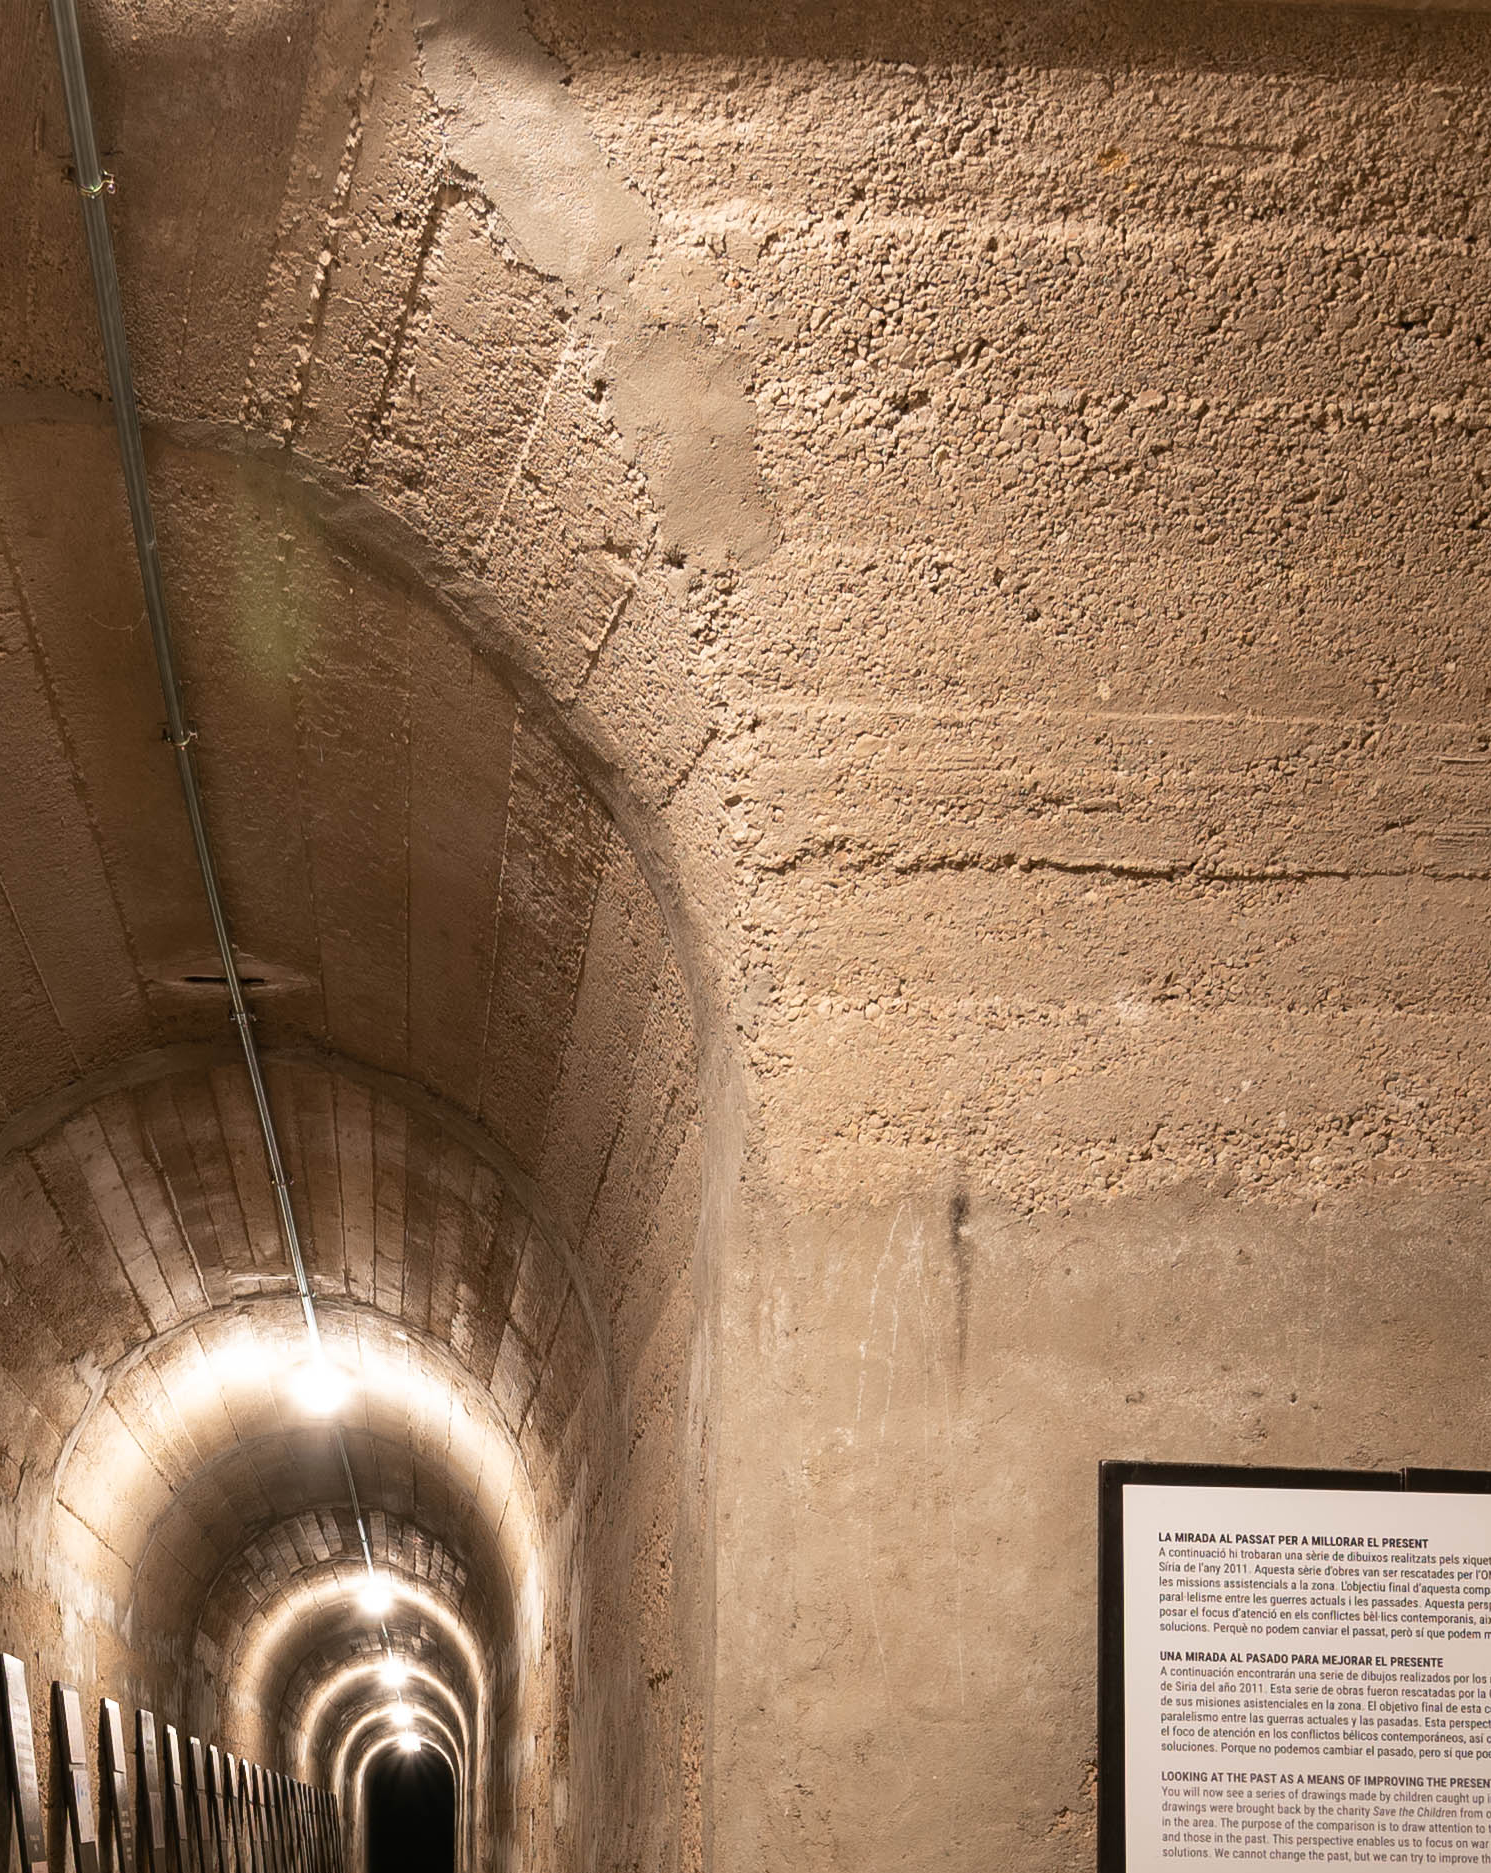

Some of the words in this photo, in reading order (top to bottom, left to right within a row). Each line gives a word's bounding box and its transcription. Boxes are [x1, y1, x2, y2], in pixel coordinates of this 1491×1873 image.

[1157, 1531, 1172, 1543] LA
[1174, 1531, 1217, 1544] MIRADA
[1218, 1532, 1233, 1544] AL
[1234, 1533, 1276, 1545] PASSAT
[1277, 1534, 1298, 1546] PER
[1300, 1534, 1309, 1546] A
[1310, 1535, 1365, 1547] MILLORAR
[1366, 1536, 1380, 1547] EL
[1380, 1536, 1429, 1549] PRESENT
[1158, 1576, 1174, 1587] les
[1175, 1576, 1221, 1588] missions
[1222, 1577, 1289, 1590] assistencials
[1290, 1581, 1297, 1590] a
[1298, 1579, 1309, 1590] la
[1387, 1581, 1410, 1593] final
[1158, 1608, 1188, 1620] posar
[1189, 1606, 1199, 1618] el
[1200, 1606, 1230, 1618] focus
[1278, 1611, 1292, 1620] en
[1293, 1609, 1309, 1620] els
[1310, 1609, 1361, 1621] conflictes
[1362, 1610, 1399, 1622] bèl·lics
[1399, 1611, 1477, 1627] contemporanis,
[1212, 1621, 1248, 1636] Perquè
[1249, 1625, 1264, 1634] no
[1264, 1623, 1300, 1637] podem
[1301, 1623, 1338, 1636] canviar
[1340, 1624, 1350, 1636] el
[1351, 1626, 1388, 1639] passat,
[1390, 1625, 1413, 1640] però
[1426, 1629, 1445, 1641] que
[1446, 1627, 1481, 1641] podem
[1159, 1650, 1183, 1662] UNA
[1184, 1651, 1227, 1663] MIRADA
[1228, 1652, 1244, 1663] AL
[1245, 1652, 1289, 1664] PASADO
[1290, 1653, 1320, 1665] PARA
[1321, 1654, 1373, 1666] MEJORAR
[1374, 1655, 1388, 1666] EL
[1389, 1655, 1444, 1668] PRESENTE
[1160, 1725, 1170, 1737] el
[1171, 1726, 1195, 1737] foco
[1196, 1726, 1210, 1738] de
[1212, 1726, 1256, 1739] atención
[1257, 1730, 1270, 1739] en
[1272, 1728, 1288, 1739] los
[1289, 1728, 1340, 1740] conflictos
[1342, 1729, 1379, 1741] bélicos
[1380, 1730, 1466, 1746] contemporáneos,
[1220, 1742, 1256, 1756] Porque
[1258, 1745, 1272, 1754] no
[1273, 1743, 1320, 1758] podemos
[1322, 1744, 1363, 1756] cambiar
[1364, 1745, 1374, 1756] el
[1376, 1745, 1416, 1760] pasado,
[1418, 1748, 1441, 1760] pero
[1454, 1749, 1474, 1761] que
[1160, 1770, 1208, 1782] LOOKING
[1209, 1771, 1224, 1783] AT
[1225, 1772, 1248, 1783] THE
[1248, 1772, 1277, 1784] PAST
[1278, 1773, 1294, 1784] AS
[1295, 1773, 1305, 1784] A
[1306, 1773, 1345, 1785] MEANS
[1346, 1774, 1361, 1786] OF
[1363, 1774, 1424, 1787] IMPROVING
[1425, 1776, 1447, 1787] THE
[1213, 1847, 1230, 1858] We
[1231, 1848, 1266, 1859] cannot
[1268, 1848, 1306, 1863] change
[1307, 1849, 1324, 1860] the
[1326, 1850, 1351, 1863] past,
[1353, 1850, 1370, 1861] but
[1372, 1852, 1387, 1861] we
[1388, 1853, 1408, 1862] can
[1409, 1852, 1424, 1865] try
[1425, 1852, 1436, 1862] to
[1438, 1851, 1479, 1866] improve
